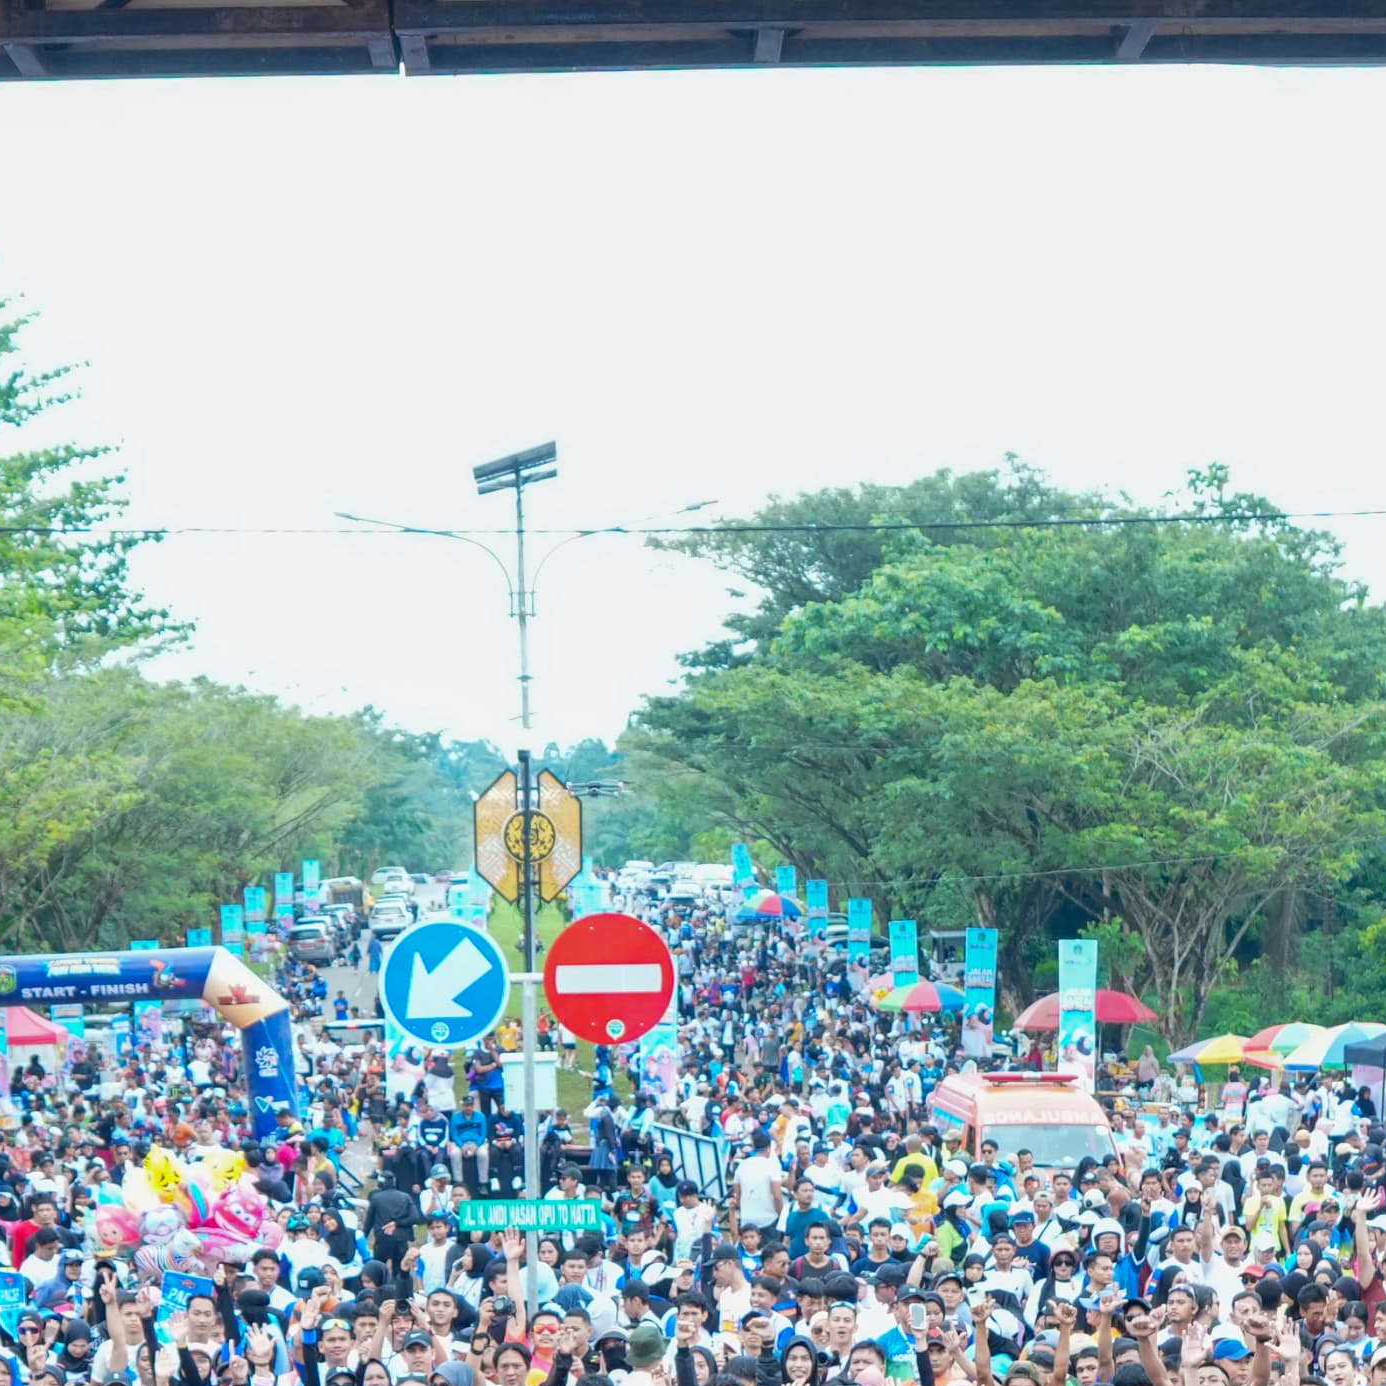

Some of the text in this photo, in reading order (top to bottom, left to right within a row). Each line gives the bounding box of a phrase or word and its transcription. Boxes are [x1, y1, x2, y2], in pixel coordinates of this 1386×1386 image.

[21, 986, 76, 999] START
[90, 983, 150, 996] FINISH
[558, 1204, 569, 1224] TO
